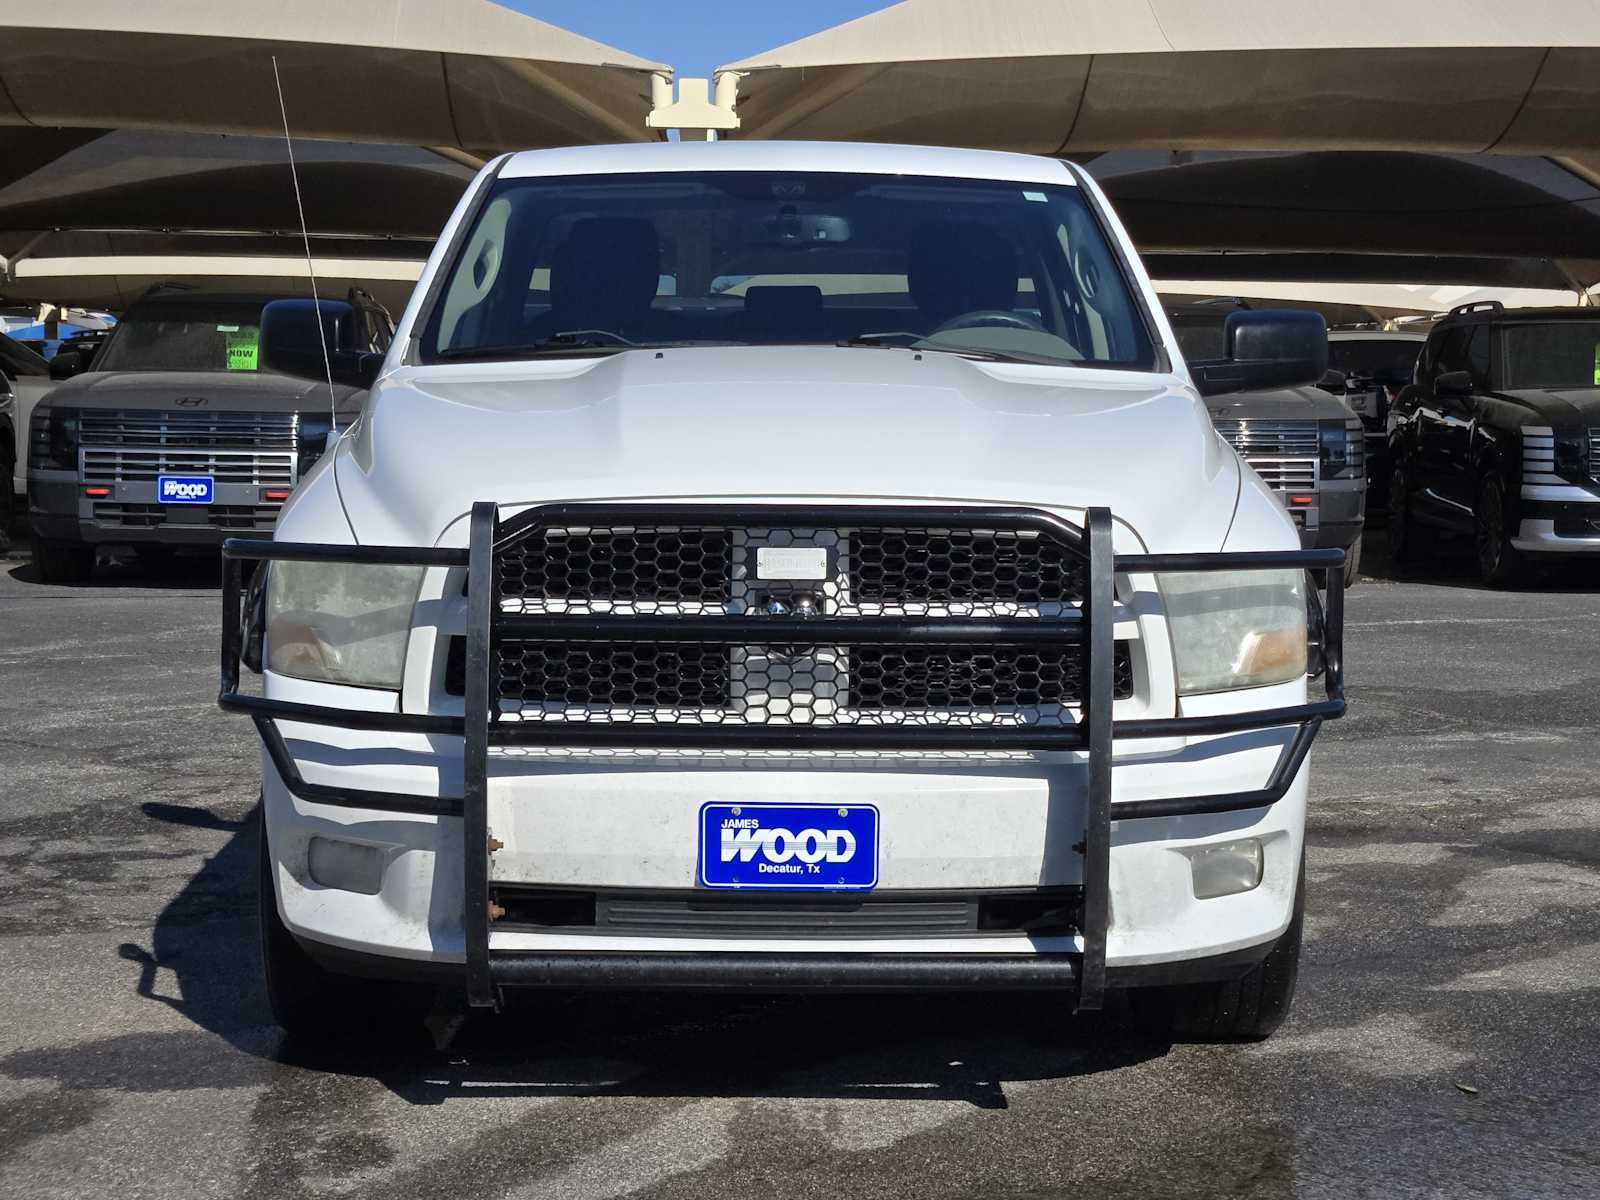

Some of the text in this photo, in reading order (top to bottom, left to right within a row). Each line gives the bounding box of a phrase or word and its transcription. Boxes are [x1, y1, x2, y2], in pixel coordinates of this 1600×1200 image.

[229, 349, 254, 358] NOW
[164, 482, 208, 497] WOOD
[721, 819, 760, 829] JAMES
[720, 828, 857, 864] WOOD
[758, 863, 821, 875] Decatur, Tx
